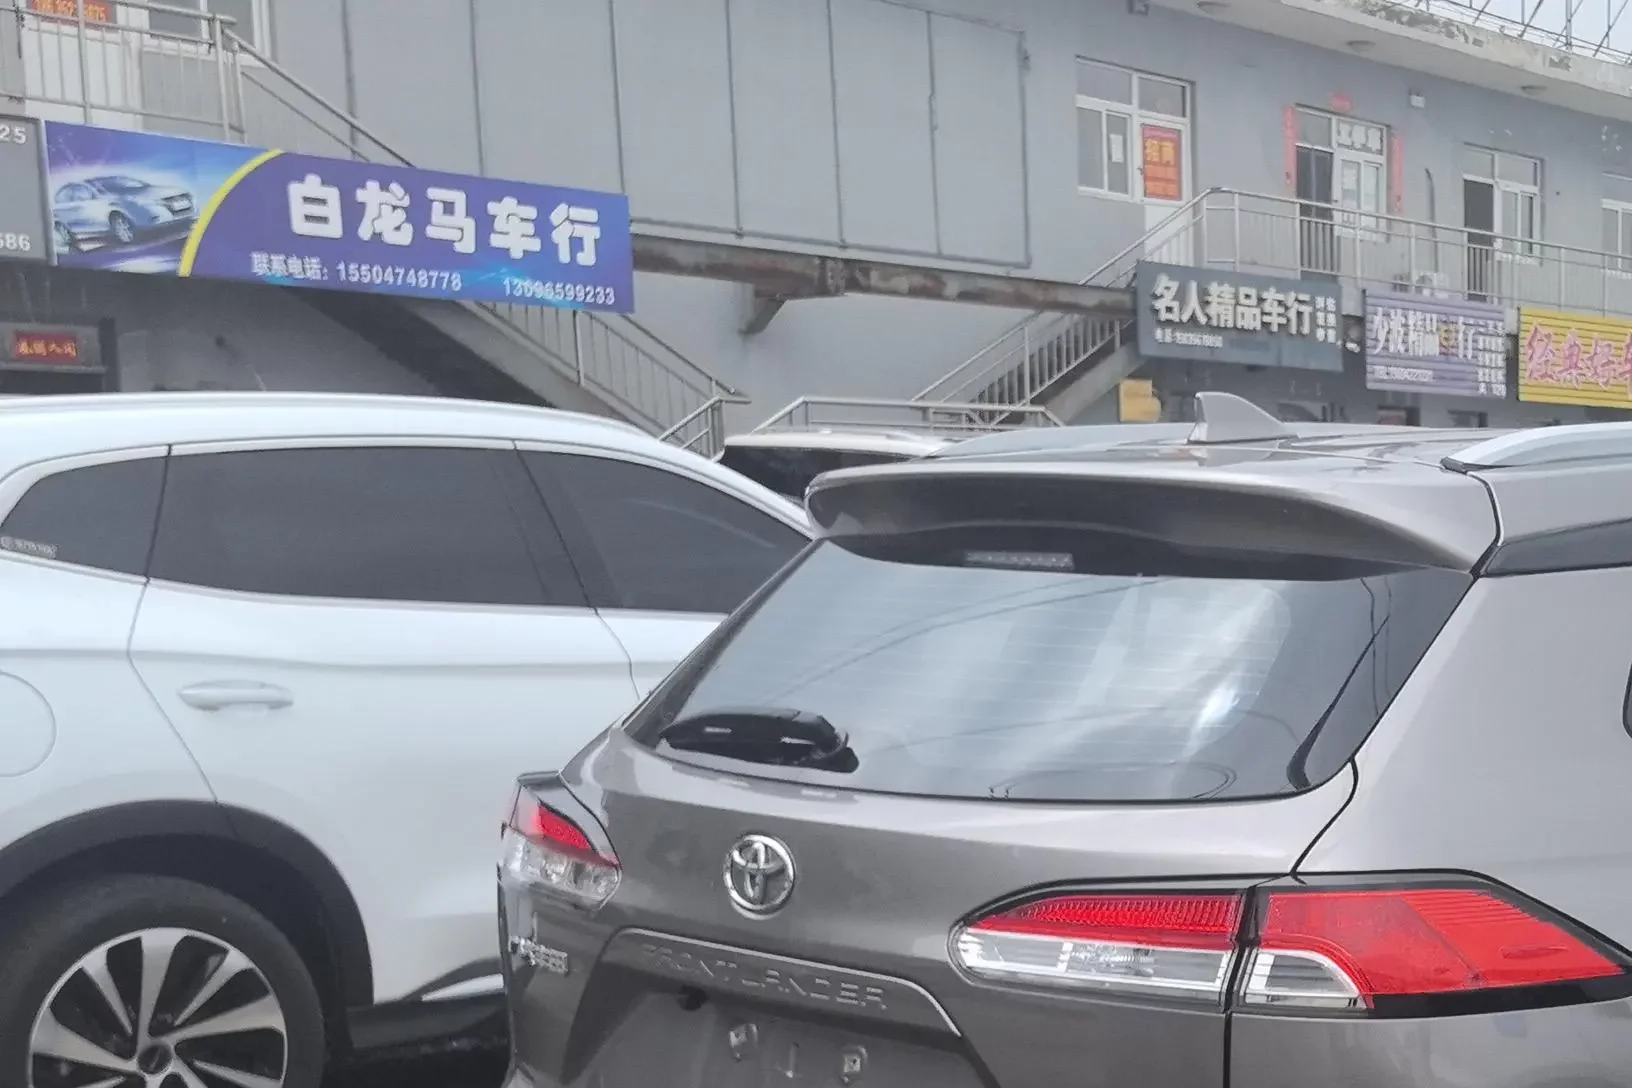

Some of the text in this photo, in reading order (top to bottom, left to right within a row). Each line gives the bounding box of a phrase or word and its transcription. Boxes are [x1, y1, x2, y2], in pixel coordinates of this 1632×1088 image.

[286, 173, 602, 267] 白龙马车行
[1151, 273, 1314, 336] 名人精品车行
